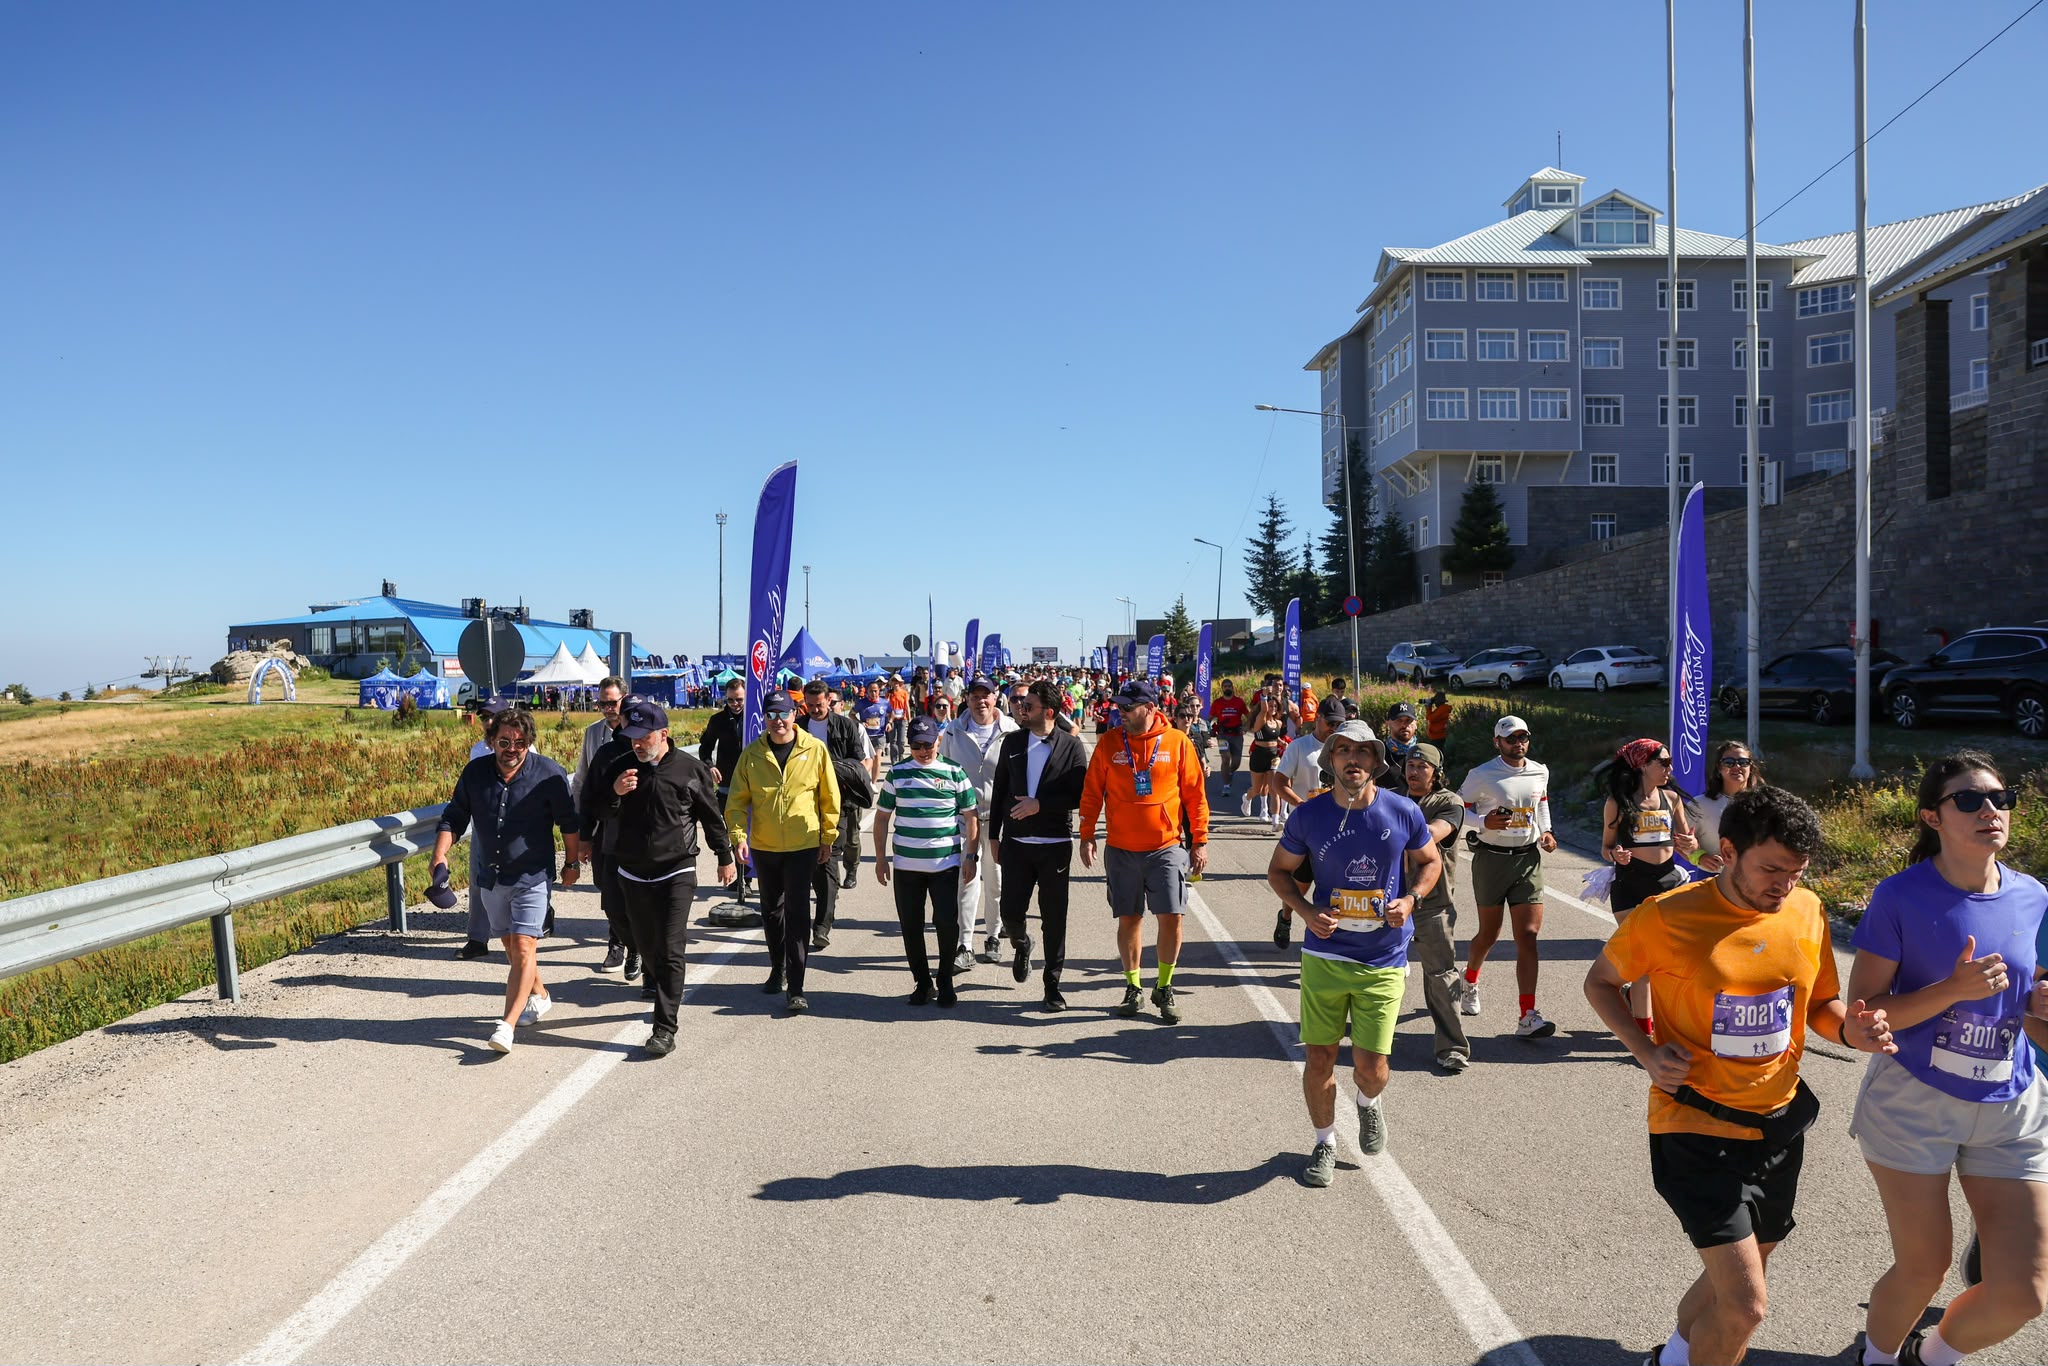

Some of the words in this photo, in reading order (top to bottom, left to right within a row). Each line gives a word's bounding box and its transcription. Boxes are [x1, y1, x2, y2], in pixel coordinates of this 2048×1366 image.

[1692, 655, 1708, 727] PREMIUM
[1641, 815, 1661, 828] 1799
[1343, 896, 1369, 912] 1740
[1734, 1002, 1774, 1027] 3021
[1960, 1022, 1997, 1050] 3011
